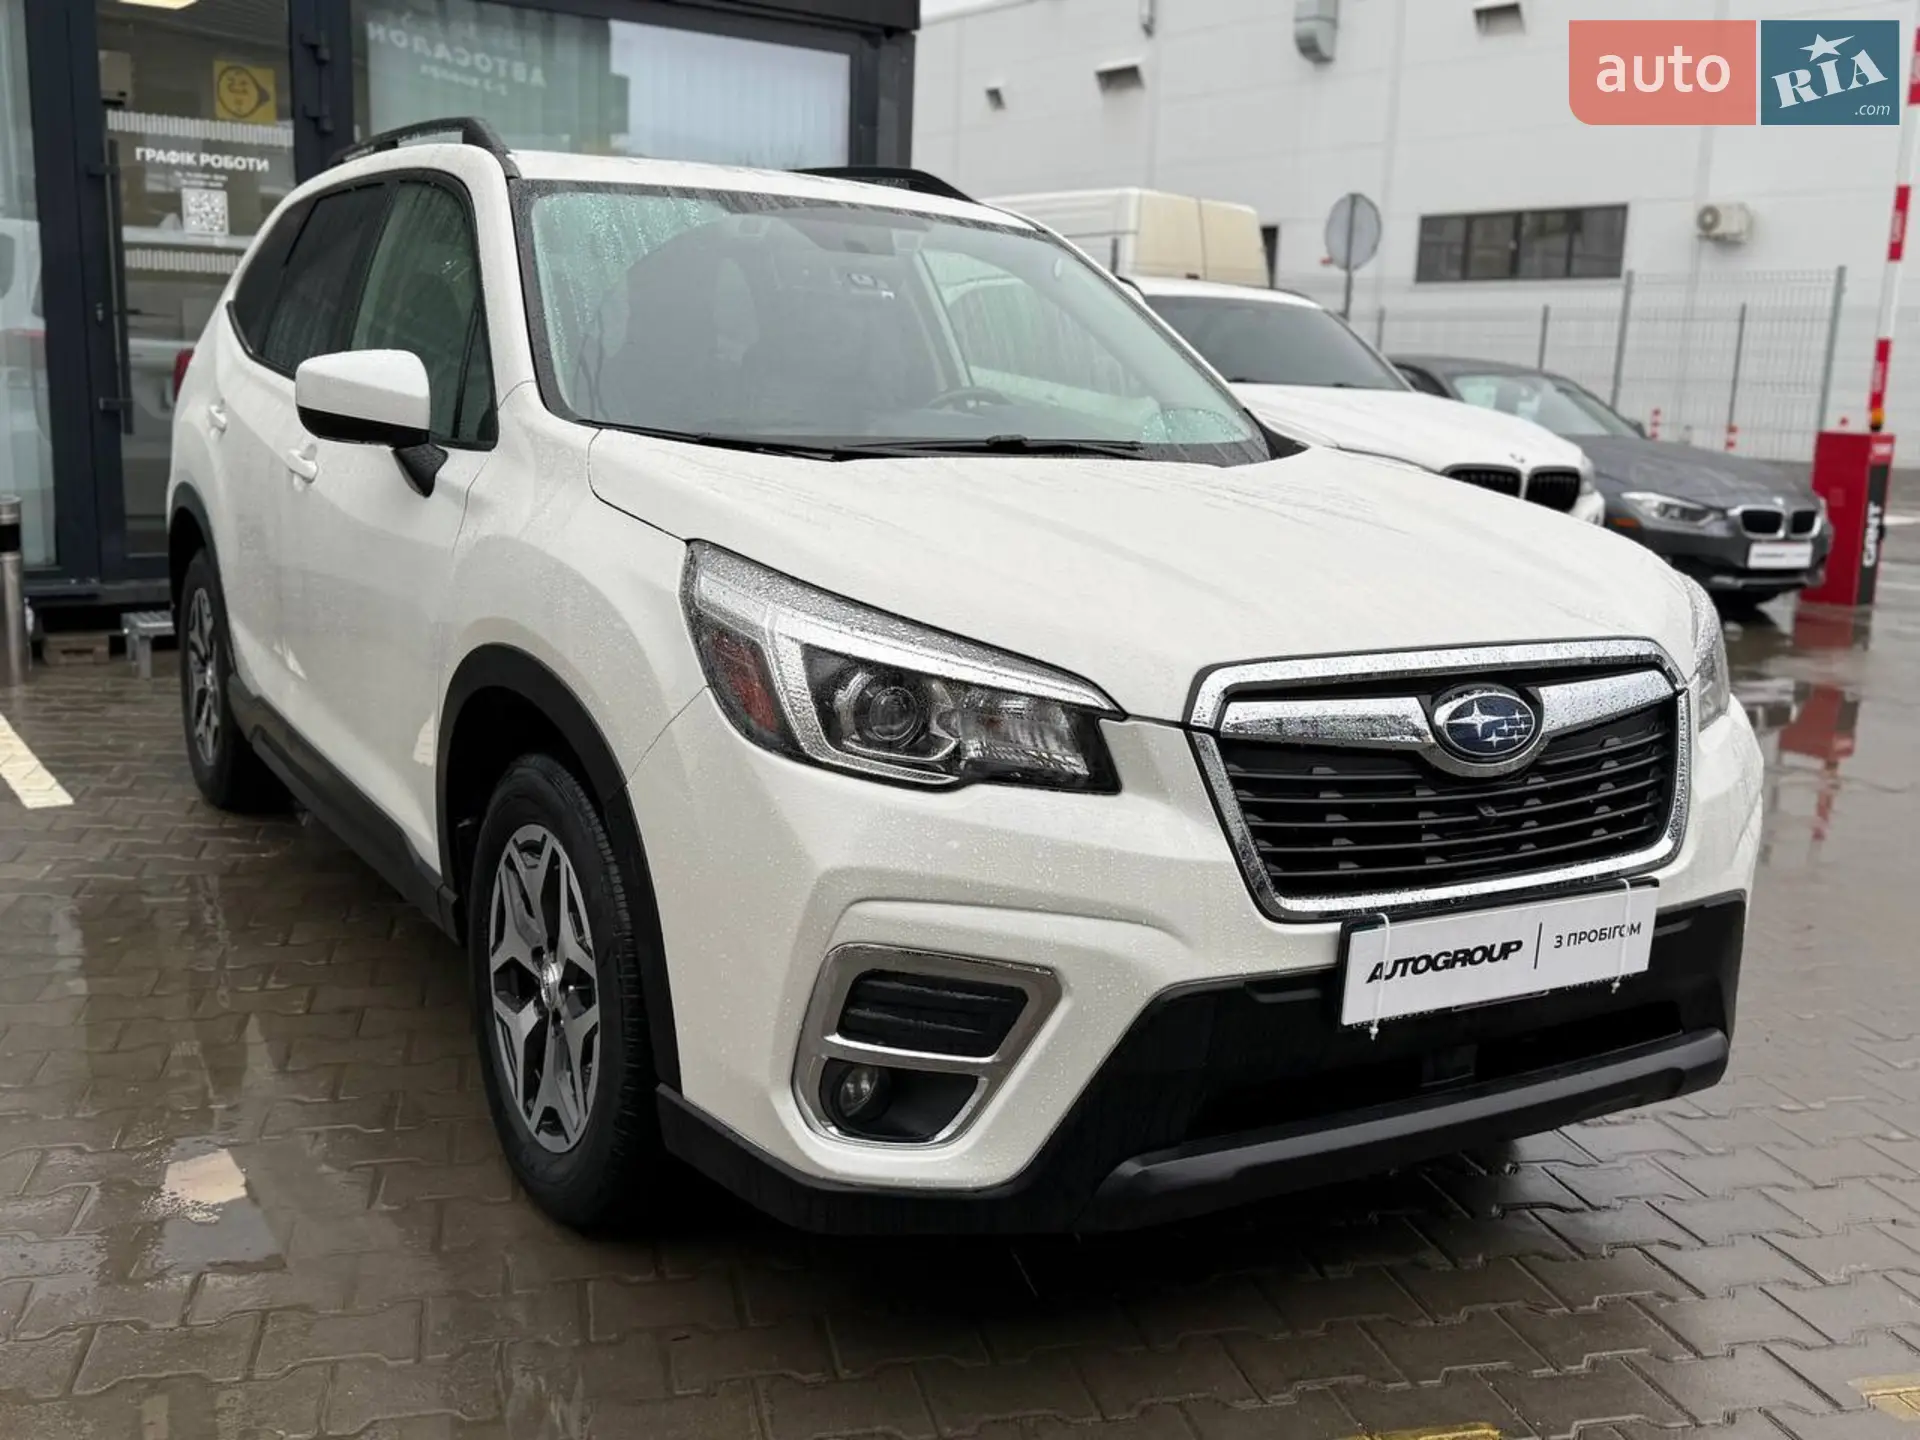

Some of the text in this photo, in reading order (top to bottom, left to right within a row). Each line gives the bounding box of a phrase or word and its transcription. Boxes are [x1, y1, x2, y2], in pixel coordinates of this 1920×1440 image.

[135, 146, 270, 173] ГРАФІК РОБОТИ
[1566, 921, 1642, 947] ПРОБІГОМ
[1366, 939, 1523, 984] AUTOGROUP
